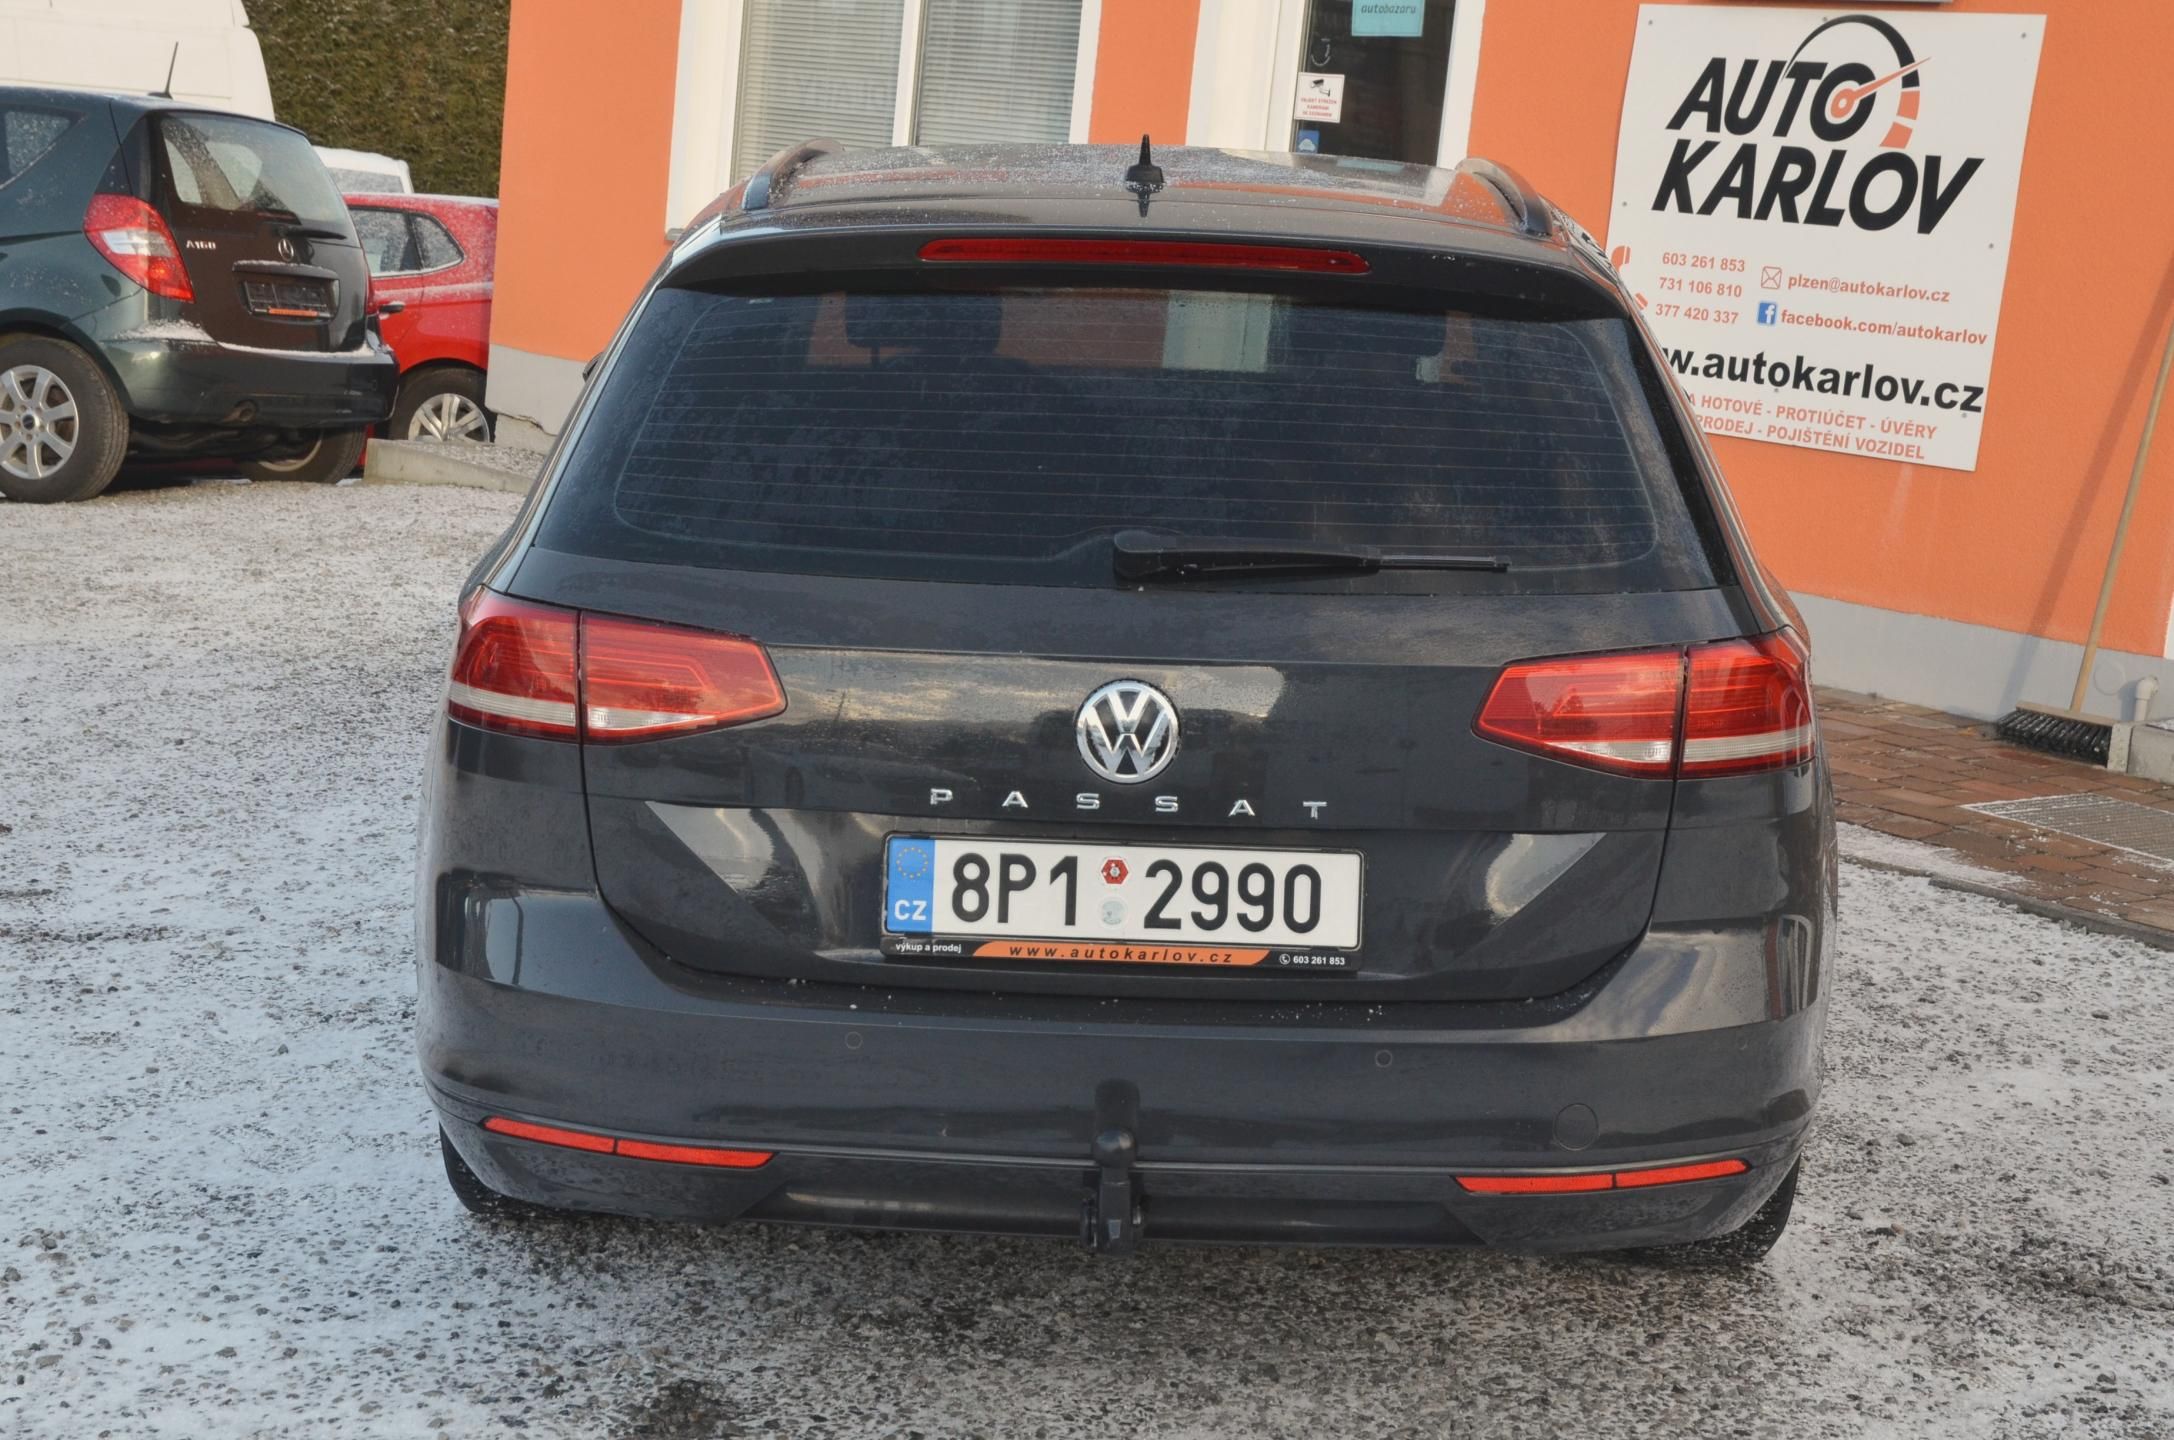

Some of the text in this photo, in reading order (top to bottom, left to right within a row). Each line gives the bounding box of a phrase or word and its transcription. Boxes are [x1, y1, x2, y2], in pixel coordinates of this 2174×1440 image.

[1665, 57, 1877, 142] AUTO
[1651, 138, 1985, 235] KARLOV
[1662, 252, 1745, 273] 603 261 853
[1659, 277, 1742, 298] 731 106 810
[1787, 274, 1950, 303] plzen@autokarlov.cz
[1656, 303, 1739, 324] 377 420 337
[1781, 309, 1988, 345] facebook.com/autokarlov
[1701, 394, 1763, 416] HOTOVÉ
[1776, 405, 1866, 430] PROTIÚČET
[1880, 416, 1937, 440] ÚVĚRY
[1767, 424, 1852, 449] POJIŠTĚNÍ
[1855, 437, 1925, 460] VOZIDEL
[929, 788, 1327, 820] PASSAT
[951, 852, 1322, 935] 8P1 2990
[894, 899, 927, 921] CZ
[896, 943, 923, 953] výkup
[932, 943, 962, 954] prodej
[1009, 946, 1232, 963] www.autokarlov.cz
[1293, 955, 1345, 966] 603 261 853
